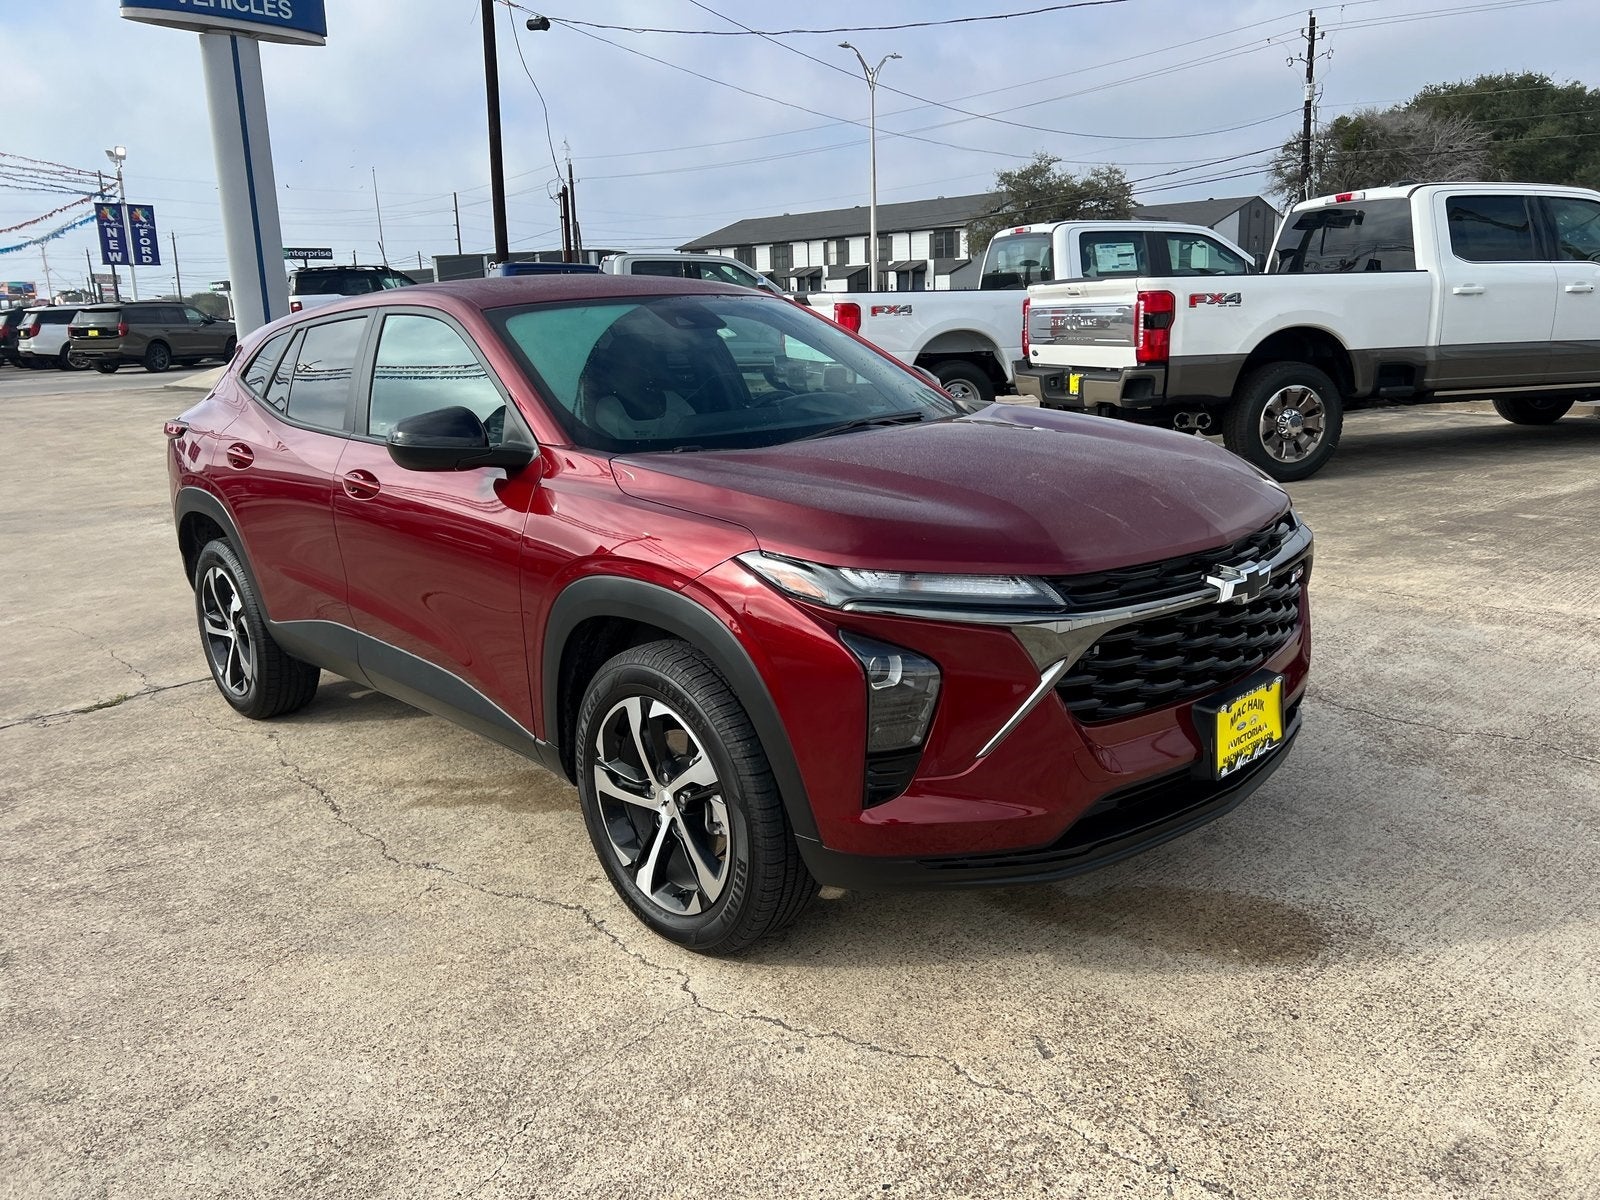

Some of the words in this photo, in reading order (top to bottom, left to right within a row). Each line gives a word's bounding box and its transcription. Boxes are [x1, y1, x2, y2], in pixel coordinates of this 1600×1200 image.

[106, 227, 122, 262] NEW
[139, 228, 153, 263] FORD
[871, 305, 912, 317] FX4
[1189, 293, 1242, 308] FX4
[1230, 702, 1246, 729] MAC
[1247, 698, 1265, 712] HAIK
